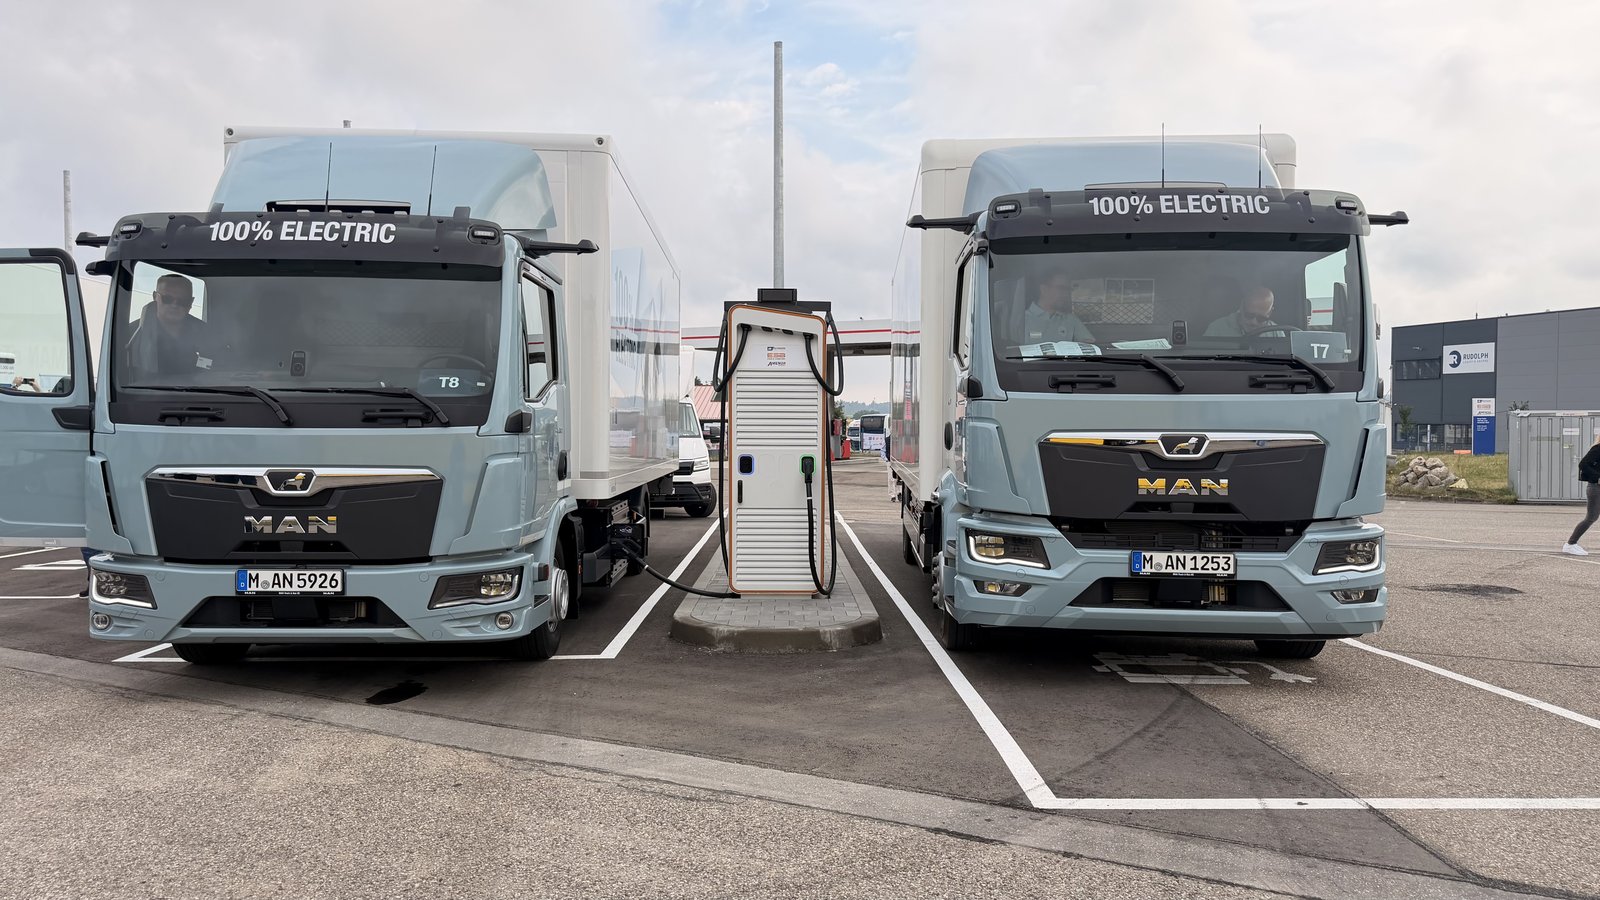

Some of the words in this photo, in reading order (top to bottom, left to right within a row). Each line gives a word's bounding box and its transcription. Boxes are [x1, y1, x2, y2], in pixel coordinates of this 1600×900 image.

[1088, 195, 1154, 216] 100%
[1159, 194, 1270, 214] ELECTRIC
[209, 220, 274, 241] 100%
[279, 220, 397, 244] ELECTRIC
[1310, 343, 1330, 359] T7
[1463, 352, 1489, 360] RUDOLPH
[438, 376, 460, 389] T8
[1138, 478, 1228, 496] MAN
[244, 515, 337, 534] MAN
[1142, 554, 1154, 570] M
[1164, 554, 1187, 571] AN
[1189, 555, 1232, 572] 1253
[248, 572, 260, 589] M
[271, 572, 294, 589] AN
[296, 573, 339, 589] 5926
